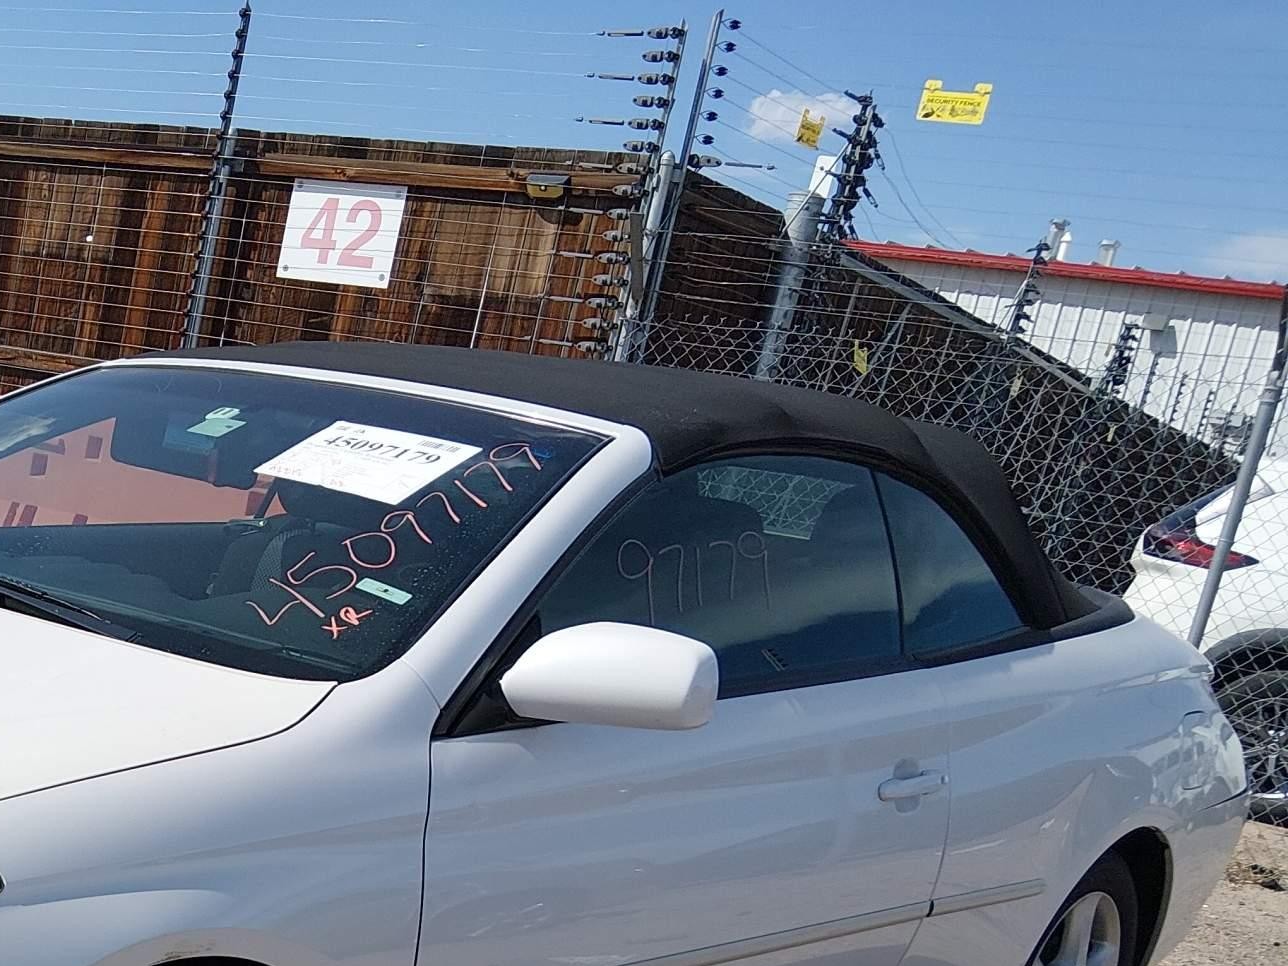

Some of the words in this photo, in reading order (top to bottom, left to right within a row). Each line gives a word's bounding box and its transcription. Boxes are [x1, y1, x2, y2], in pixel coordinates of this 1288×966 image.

[300, 197, 383, 269] 42
[323, 435, 442, 465] 45097179
[246, 442, 543, 626] 45097179
[618, 531, 772, 626] 97179
